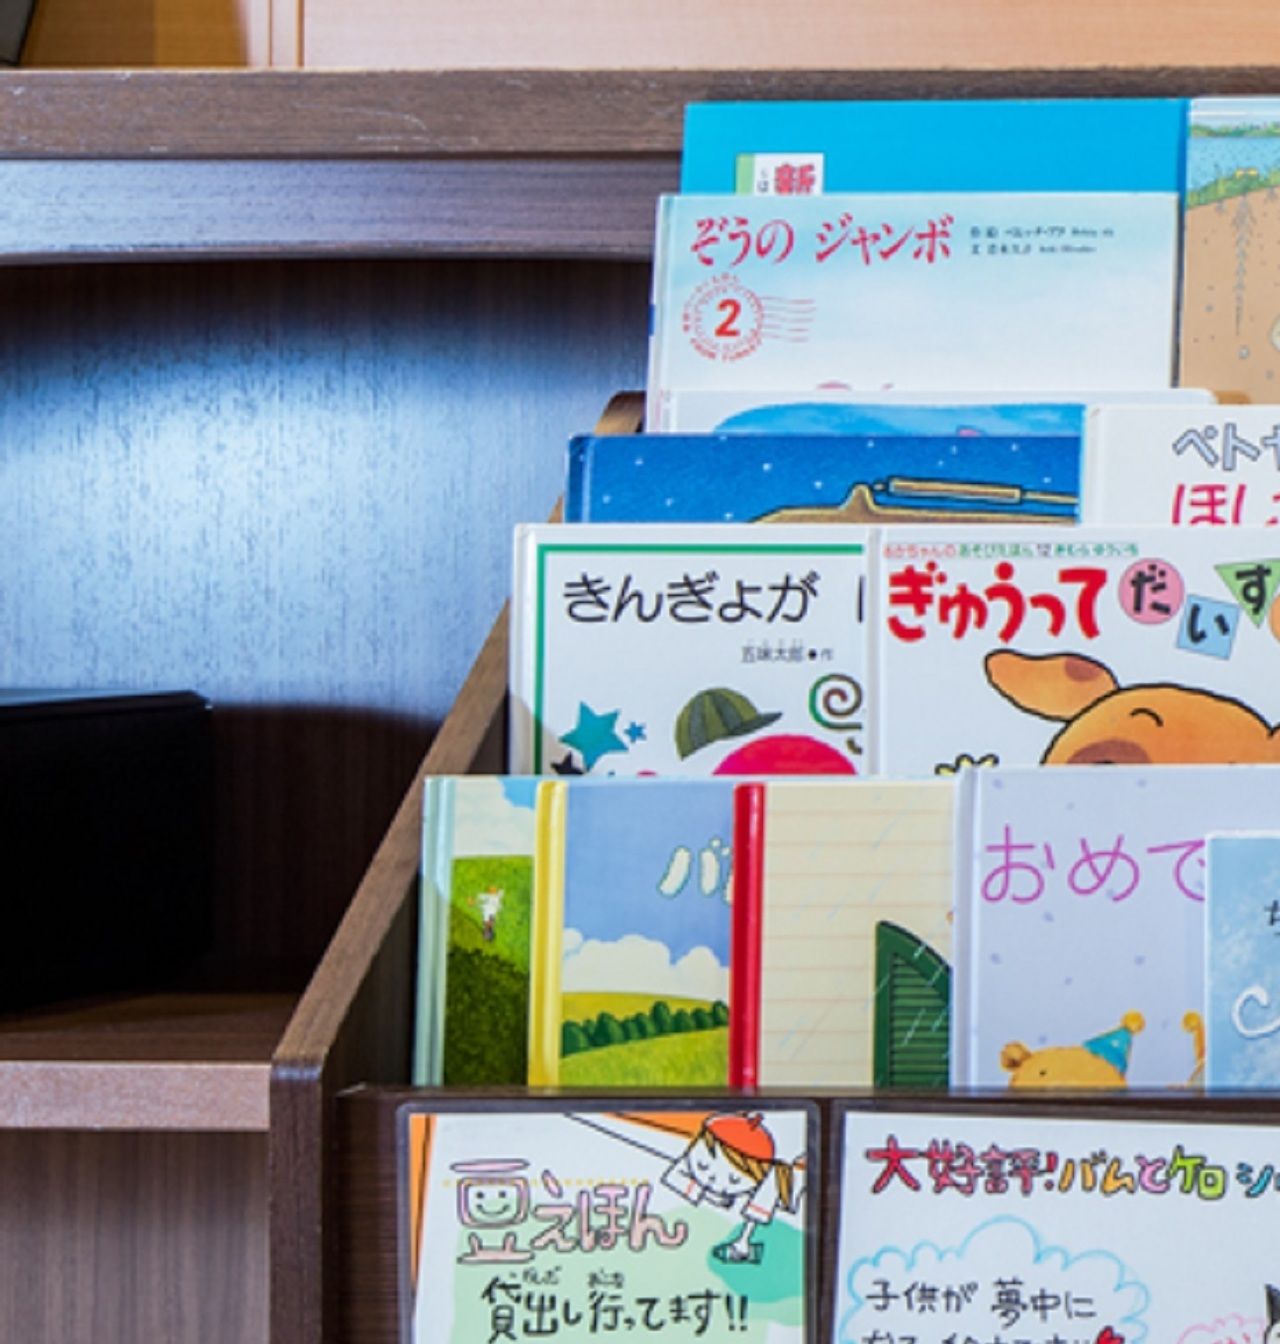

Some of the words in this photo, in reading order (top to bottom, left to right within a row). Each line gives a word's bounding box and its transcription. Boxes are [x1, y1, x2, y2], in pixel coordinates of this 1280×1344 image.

[690, 216, 795, 268] ぞうの
[816, 212, 954, 267] ジャンボ
[714, 298, 741, 337] 2
[564, 571, 820, 624] きんぎょが
[888, 561, 1108, 643] ぎゅうって
[450, 1158, 688, 1265] 豆えほん
[865, 1279, 979, 1314] 子供が
[990, 1277, 1097, 1328] 夢中に
